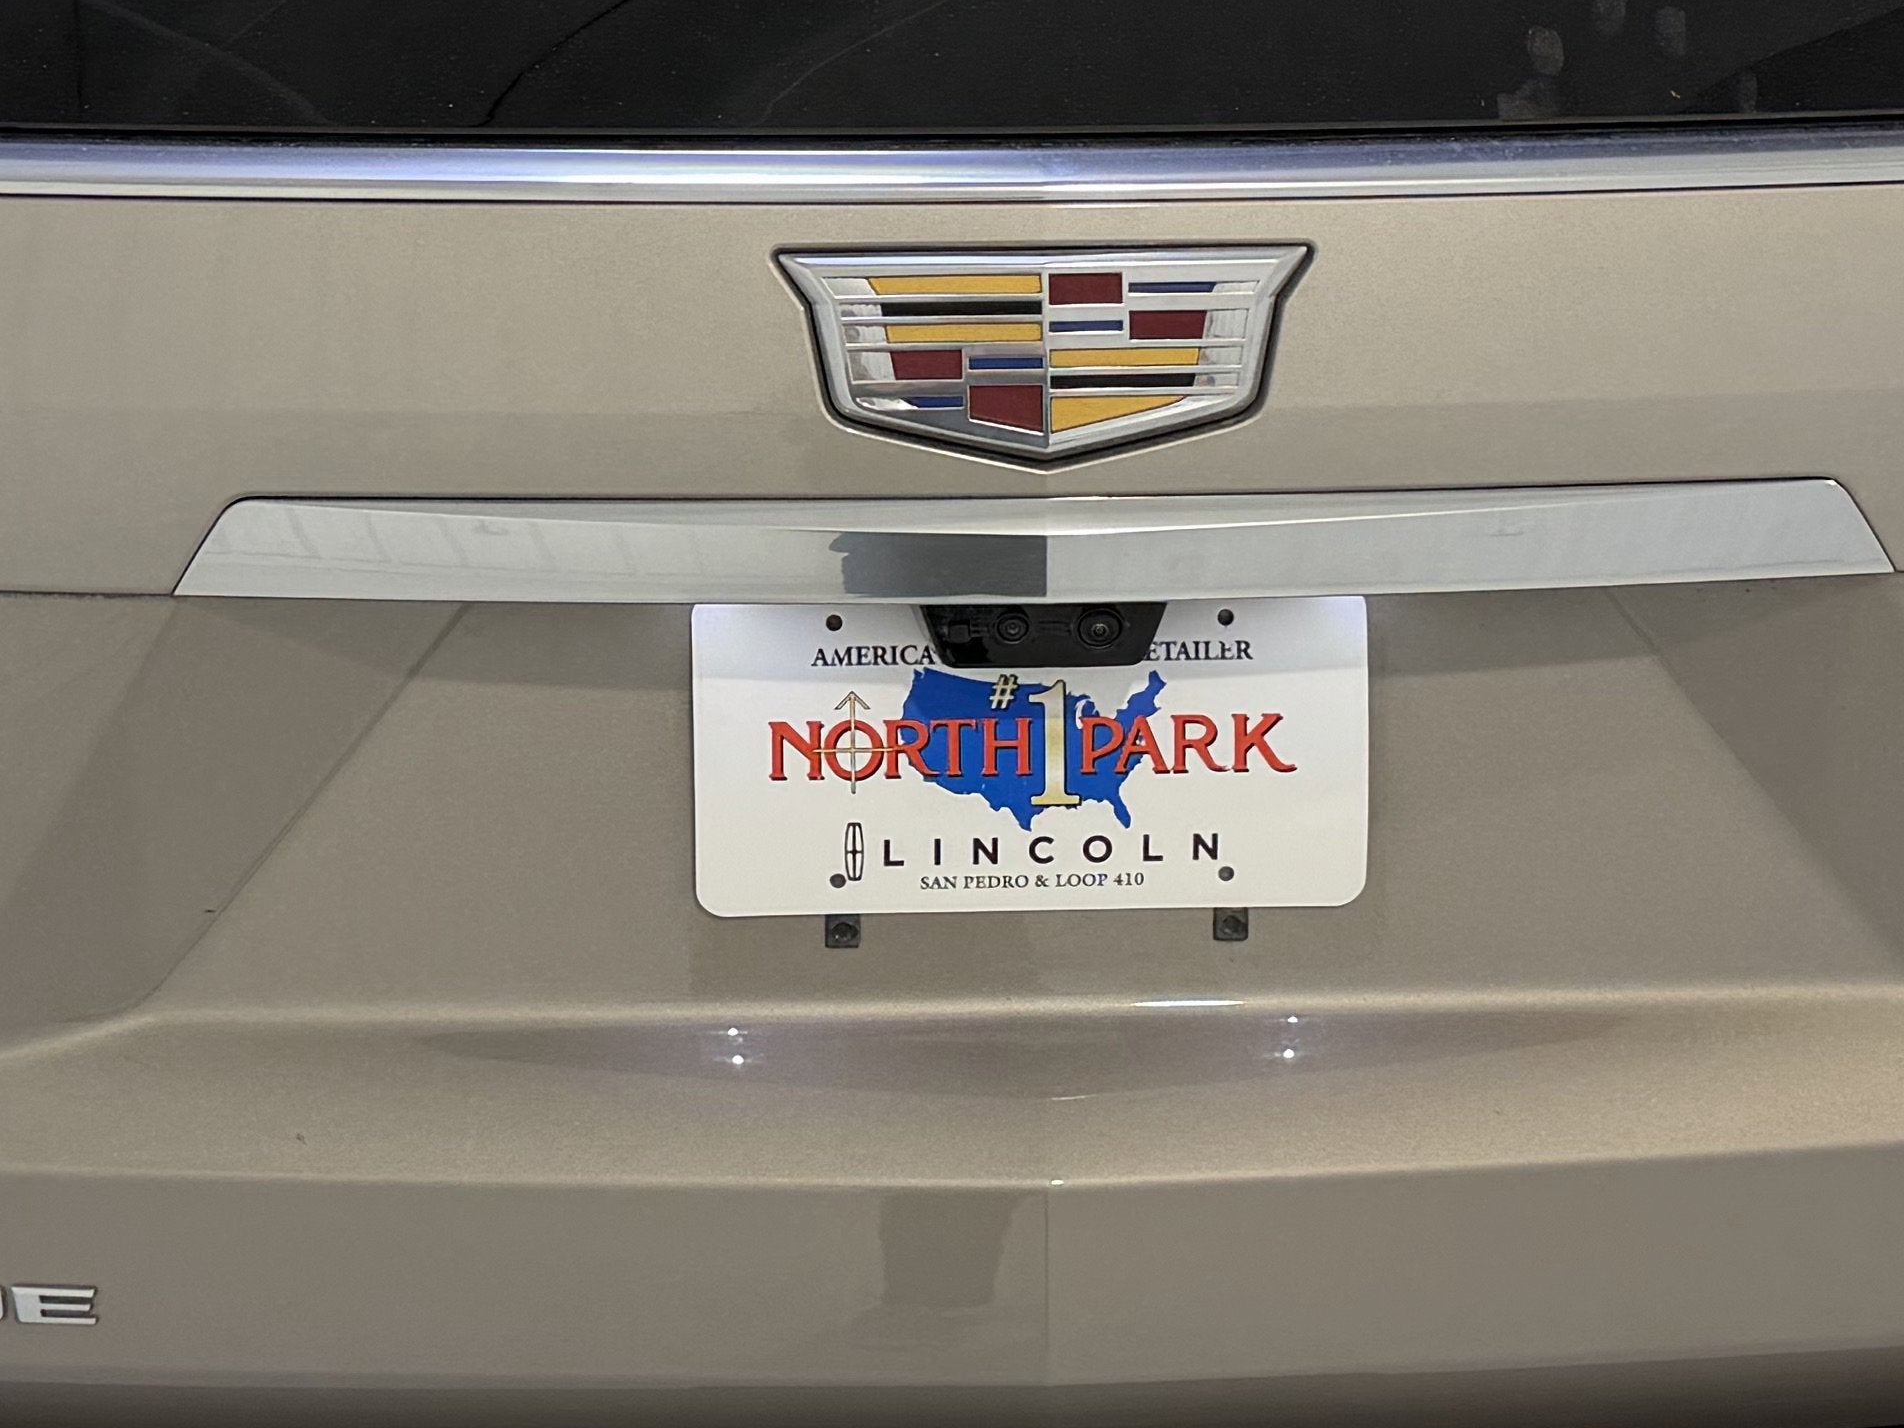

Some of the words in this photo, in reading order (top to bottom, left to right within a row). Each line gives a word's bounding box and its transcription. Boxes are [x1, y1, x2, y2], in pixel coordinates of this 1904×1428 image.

[810, 644, 937, 667] AMERICA
[1143, 640, 1254, 662] ETAILER
[768, 715, 1032, 783] NORTH
[1080, 712, 1298, 776] PARK
[883, 832, 1220, 867] LINCOLN
[920, 875, 956, 890] SAN
[962, 874, 1029, 890] PEDRO
[1035, 874, 1050, 889] &
[1055, 873, 1108, 889] LOOP
[1113, 872, 1145, 888] 410
